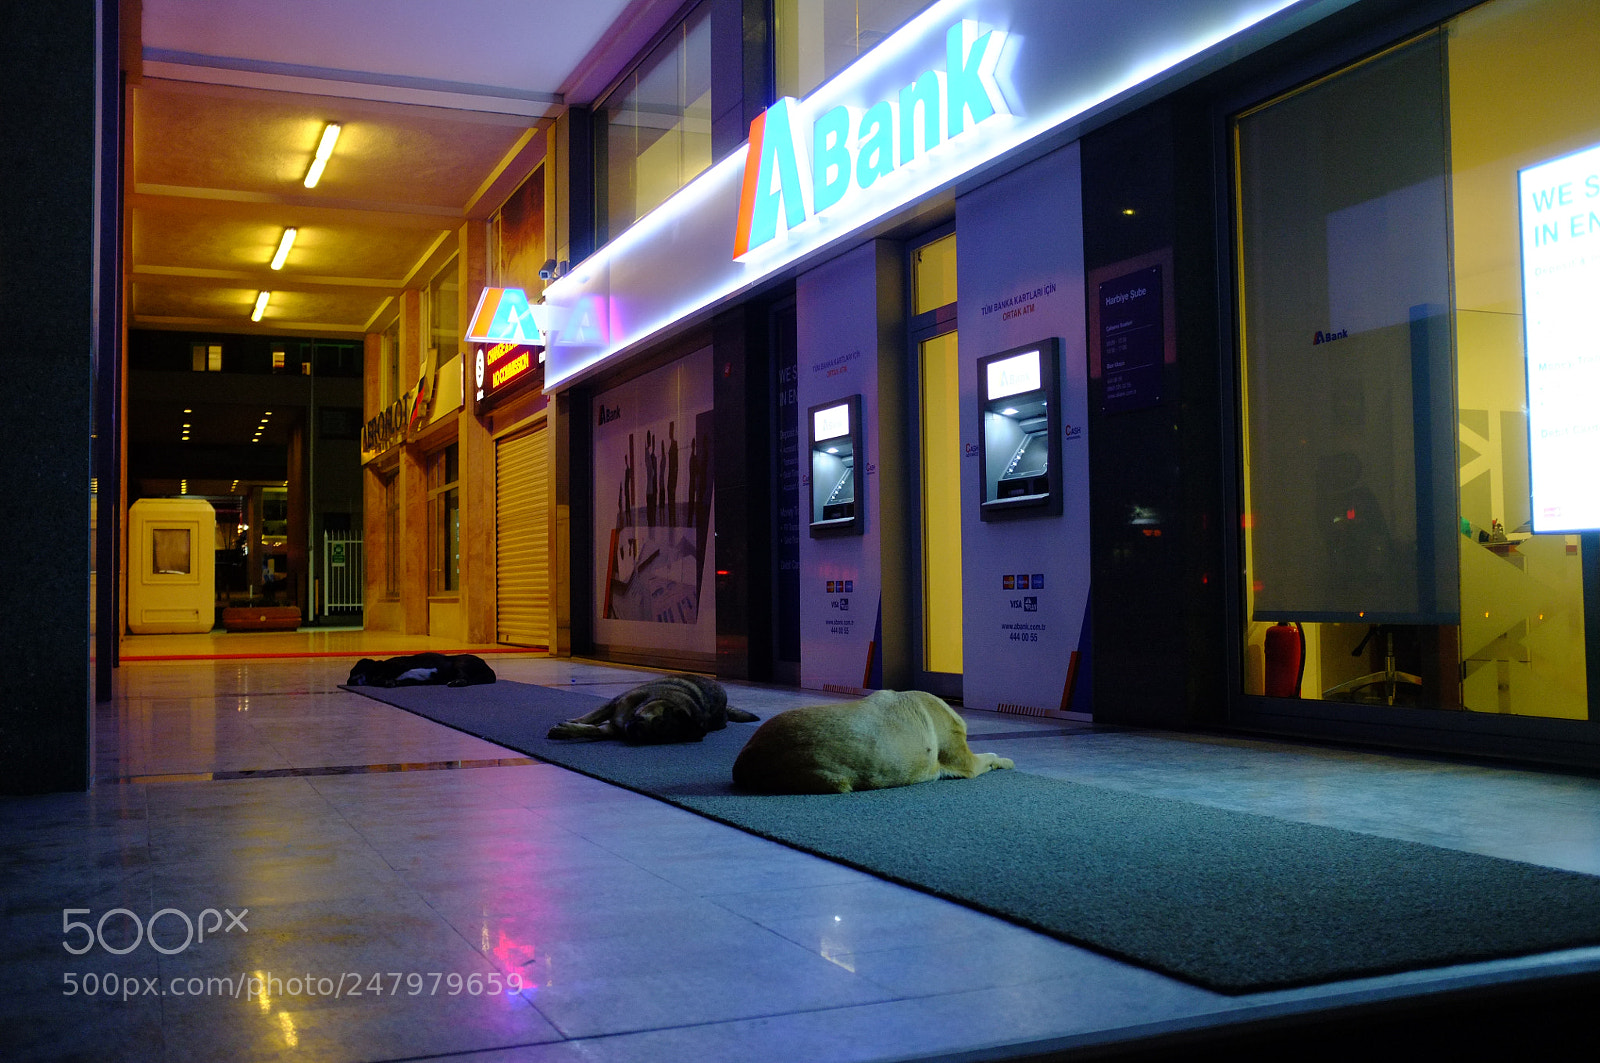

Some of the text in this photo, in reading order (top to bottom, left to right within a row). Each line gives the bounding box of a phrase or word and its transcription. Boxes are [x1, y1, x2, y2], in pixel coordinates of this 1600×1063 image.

[733, 19, 996, 260] ABank
[1532, 181, 1573, 213] WE
[1534, 220, 1559, 248] IN
[981, 303, 993, 315] TÜM
[994, 299, 1013, 312] BANKA
[1014, 287, 1043, 304] KARTLARI
[1002, 304, 1035, 321] ORTAK ATM
[1313, 329, 1349, 345] ABank
[1009, 600, 1022, 609] VISA
[1001, 623, 1046, 631] www.abank.com.tr
[1009, 632, 1020, 641] 444
[1021, 632, 1029, 642] 00
